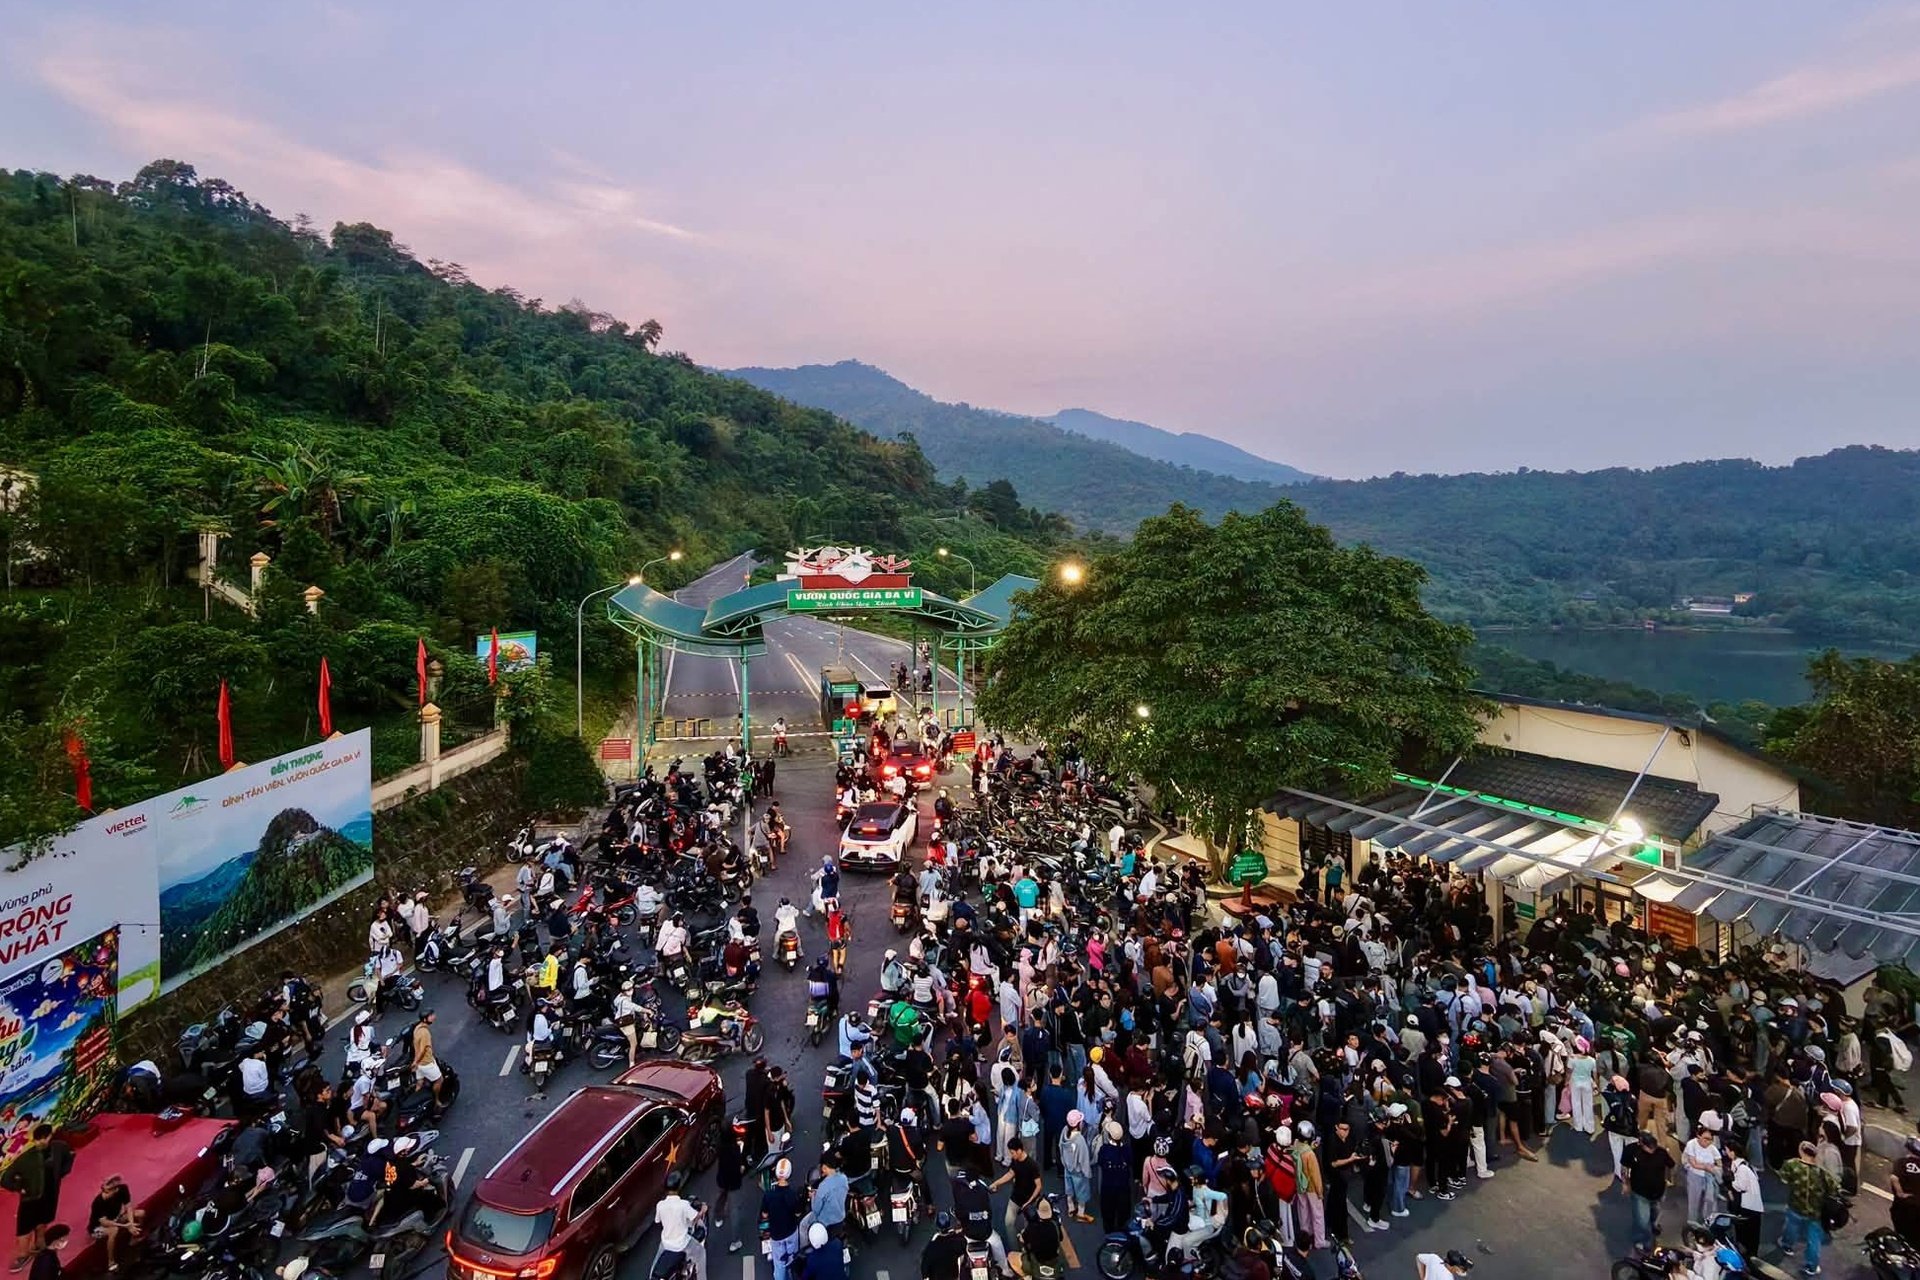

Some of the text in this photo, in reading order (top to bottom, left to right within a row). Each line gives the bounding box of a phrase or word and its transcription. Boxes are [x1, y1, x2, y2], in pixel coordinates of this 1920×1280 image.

[863, 591, 882, 600] GIA
[885, 591, 901, 599] BA
[106, 814, 147, 835] viettel
[0, 883, 53, 912] Vùng phủ
[0, 894, 72, 939] RỘNG
[0, 920, 68, 964] NHẤT
